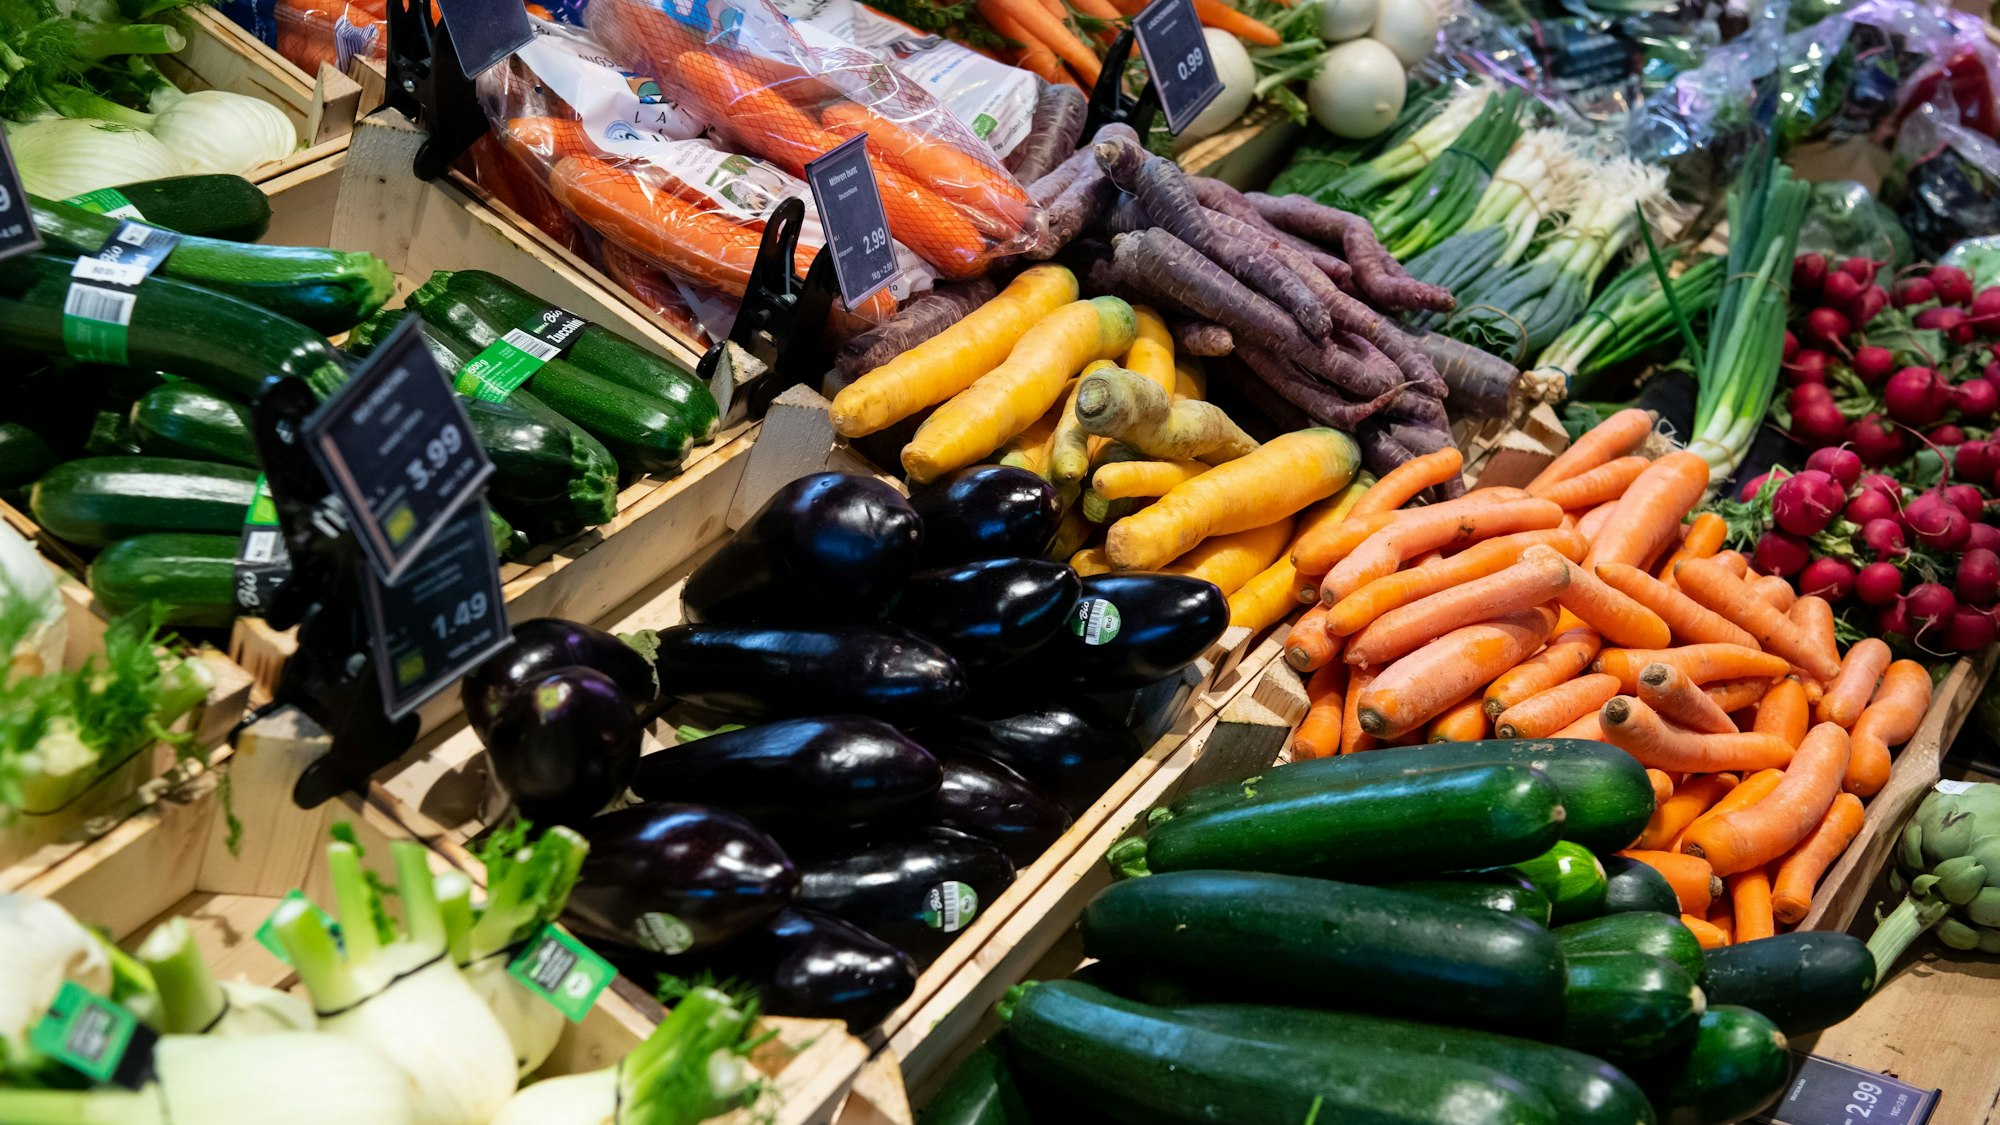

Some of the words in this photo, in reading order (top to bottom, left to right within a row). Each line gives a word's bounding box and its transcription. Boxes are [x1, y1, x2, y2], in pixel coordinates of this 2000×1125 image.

[1177, 47, 1204, 80] 0.99
[829, 172, 847, 187] Möhren
[846, 165, 858, 178] bunt
[863, 227, 886, 255] 2.99
[543, 310, 563, 323] Bio
[546, 317, 585, 343] Zucchini
[406, 424, 462, 491] 3.99
[237, 571, 260, 607] Bio
[431, 591, 488, 640] 1.49
[1079, 601, 1090, 621] Bio
[930, 888, 943, 912] Bio
[1845, 1081, 1882, 1118] 2.99
